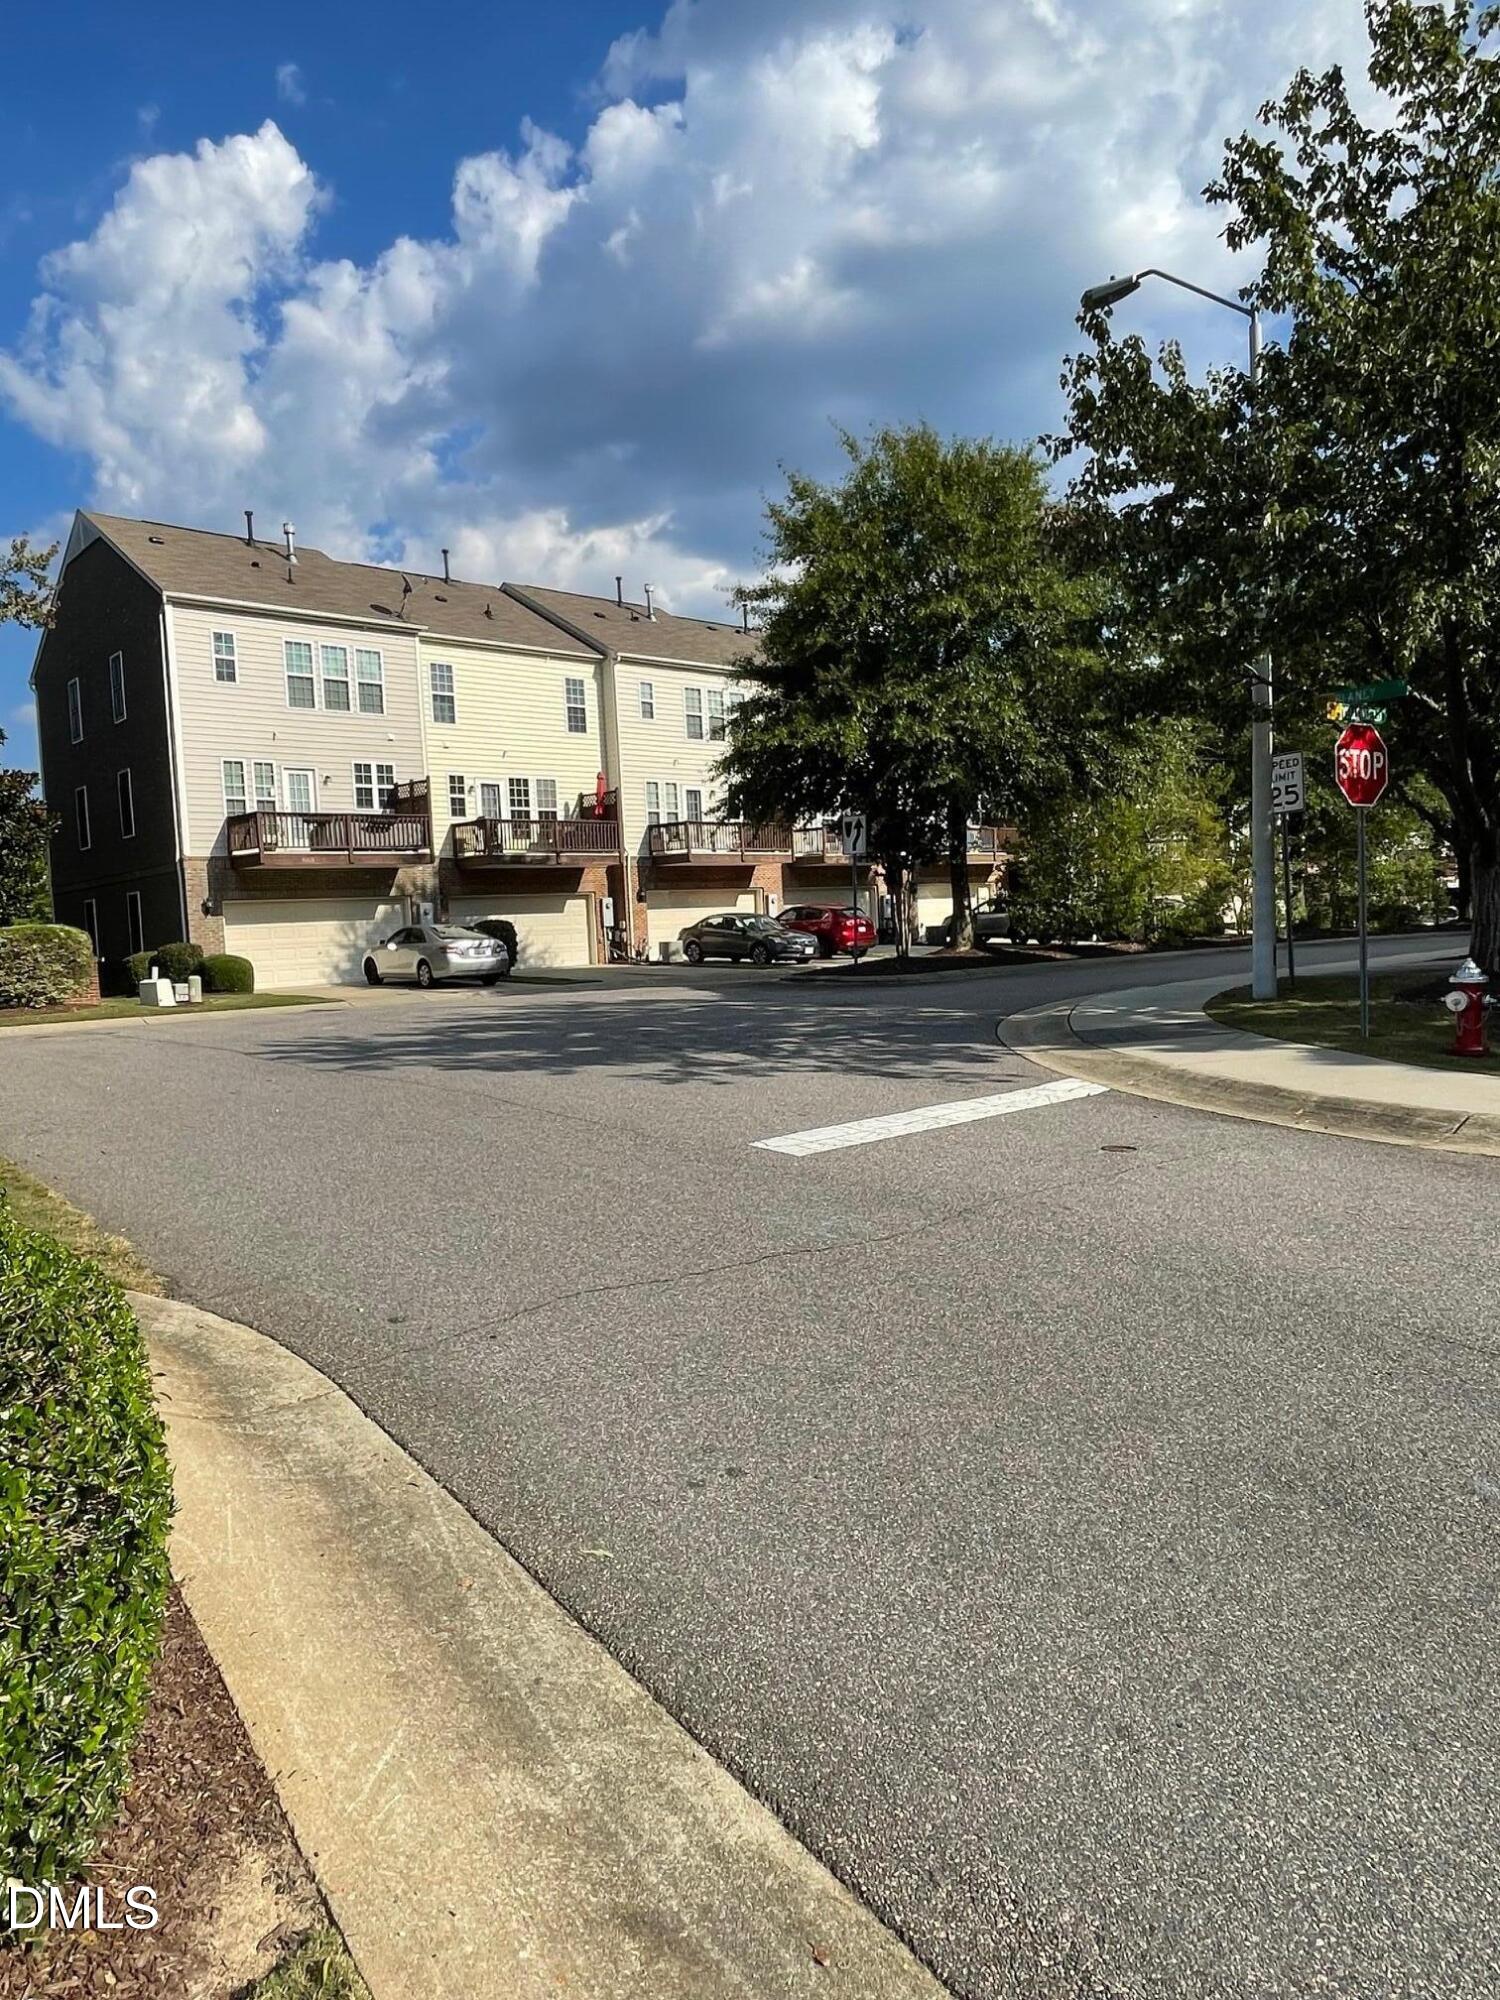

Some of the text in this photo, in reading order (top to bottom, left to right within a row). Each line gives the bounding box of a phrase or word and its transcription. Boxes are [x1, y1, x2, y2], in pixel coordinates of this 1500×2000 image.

[1272, 758, 1299, 769] PEED
[1339, 748, 1384, 780] STOP
[1272, 770, 1296, 783] IMIT
[1272, 784, 1299, 807] 25
